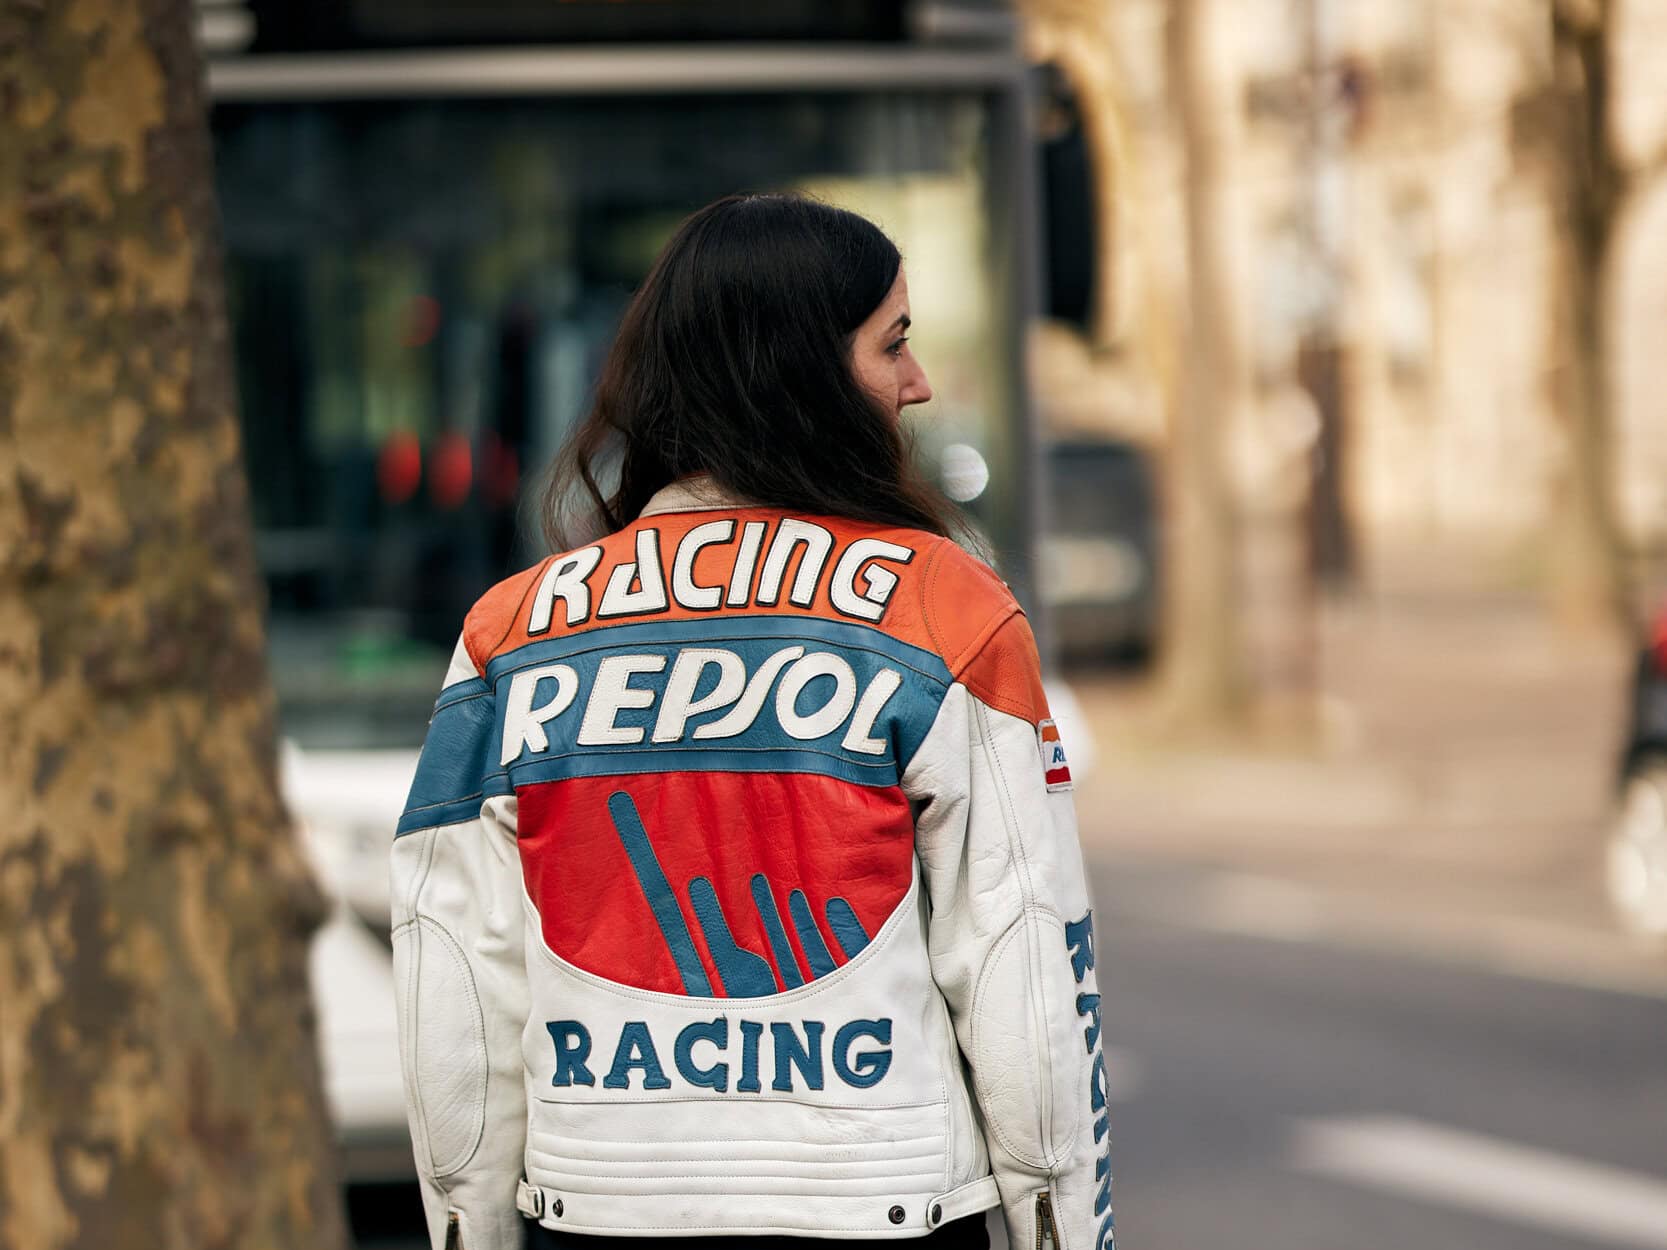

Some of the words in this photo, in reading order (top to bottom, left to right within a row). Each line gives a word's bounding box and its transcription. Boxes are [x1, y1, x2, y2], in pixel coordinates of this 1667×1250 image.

[527, 518, 913, 635] RACING
[500, 645, 903, 765] REPSOL
[546, 1015, 893, 1093] RACING
